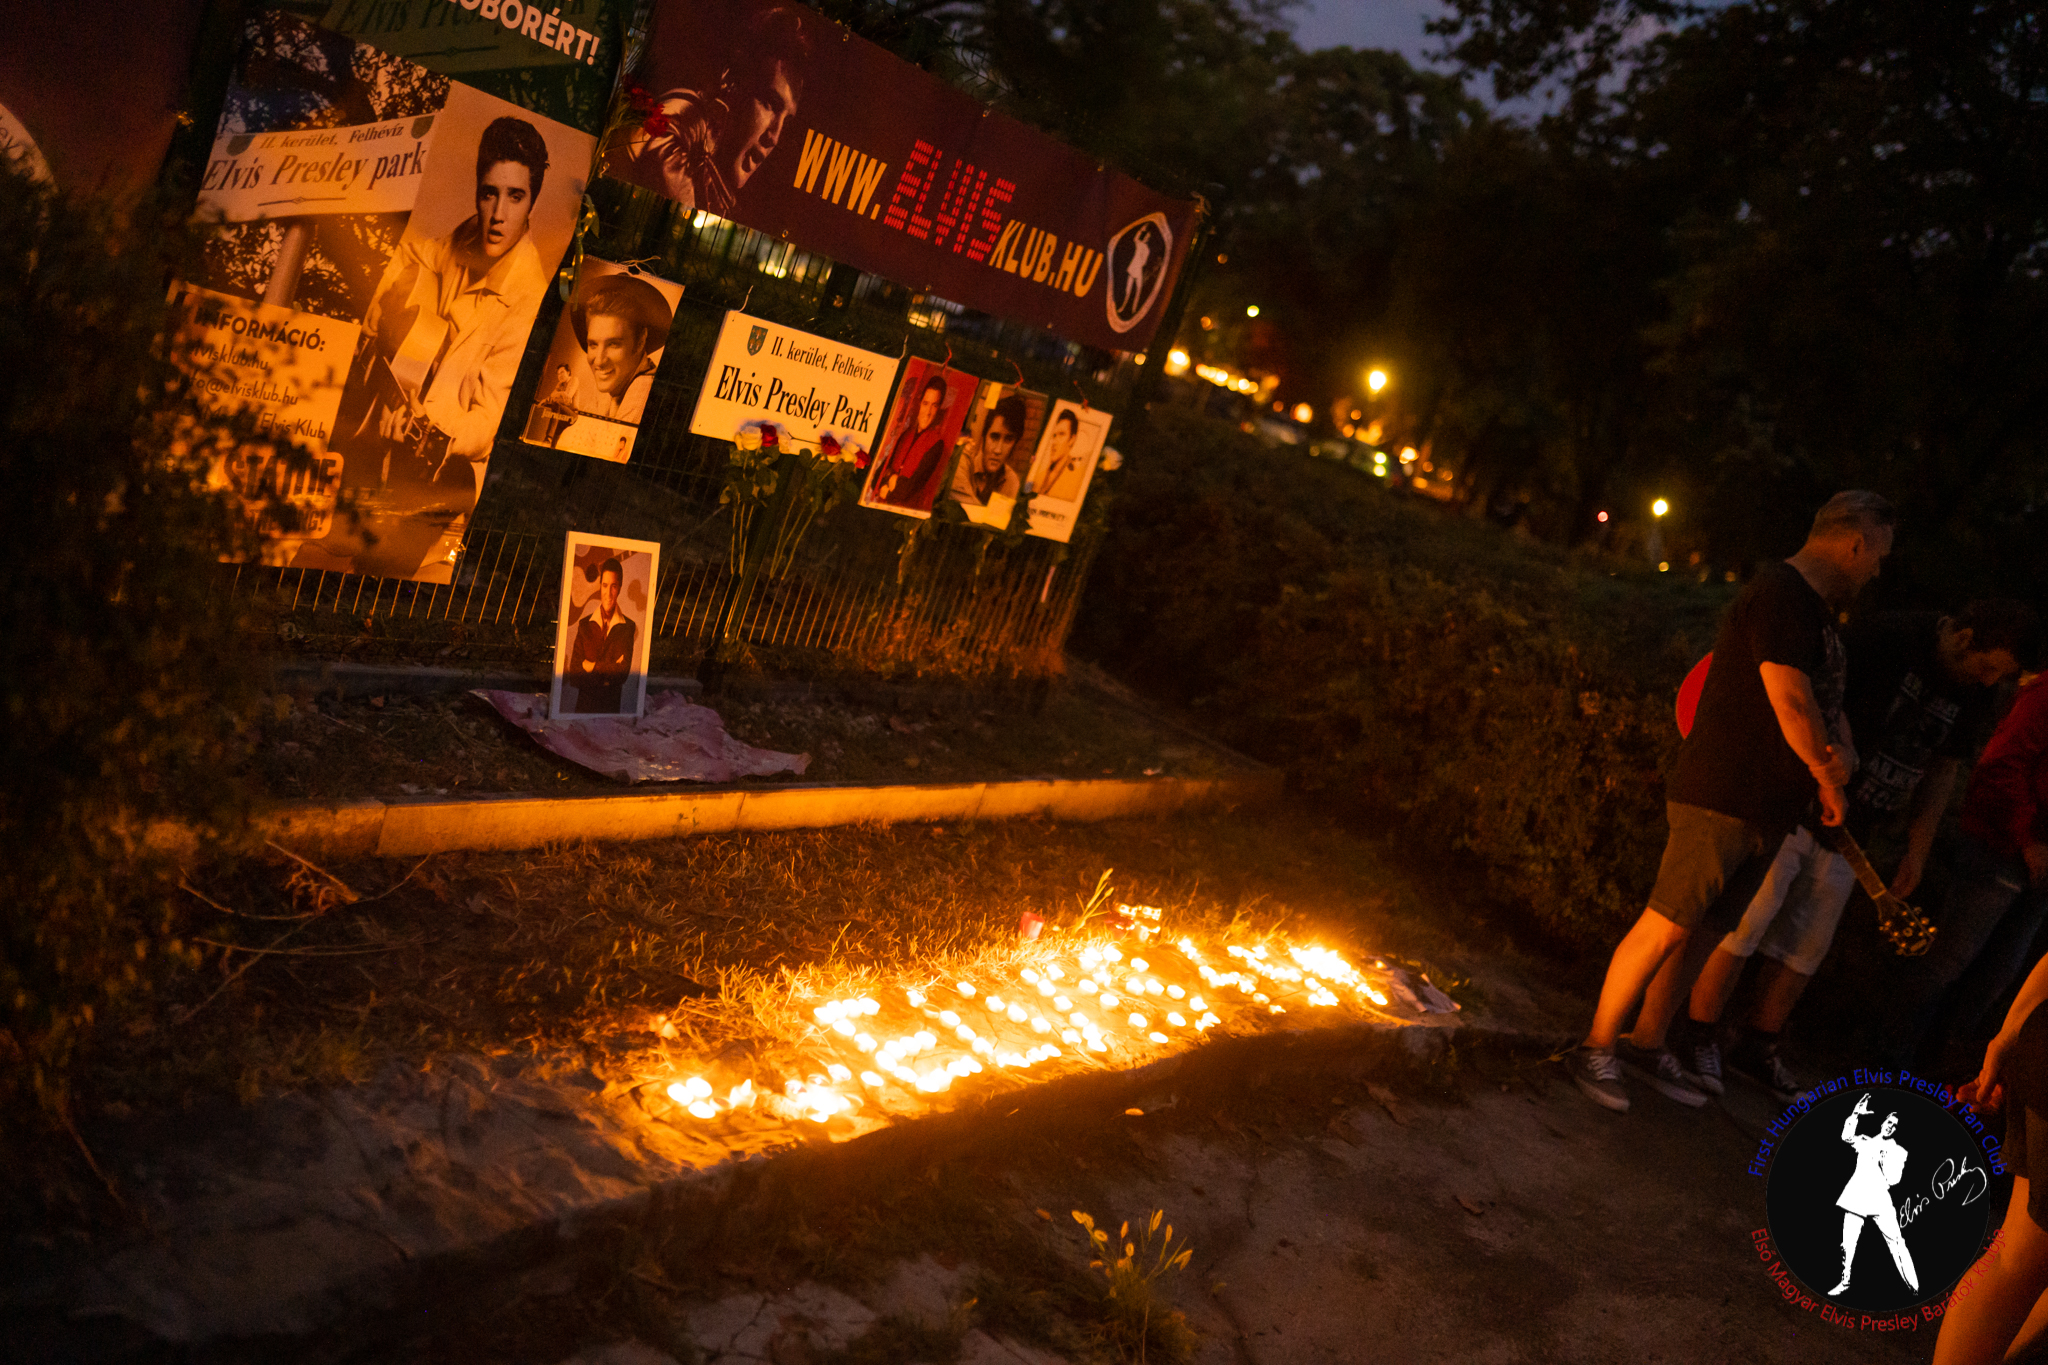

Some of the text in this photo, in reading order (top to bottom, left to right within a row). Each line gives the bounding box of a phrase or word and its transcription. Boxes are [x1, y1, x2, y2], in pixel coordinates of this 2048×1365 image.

[259, 124, 404, 149] II. kerület, Felhévíz
[201, 141, 427, 191] Elvis Presley park
[771, 336, 874, 382] II. kerület, Felhévíz
[713, 364, 873, 433] Elvis Presley Park
[260, 412, 327, 439] Elvis Klub
